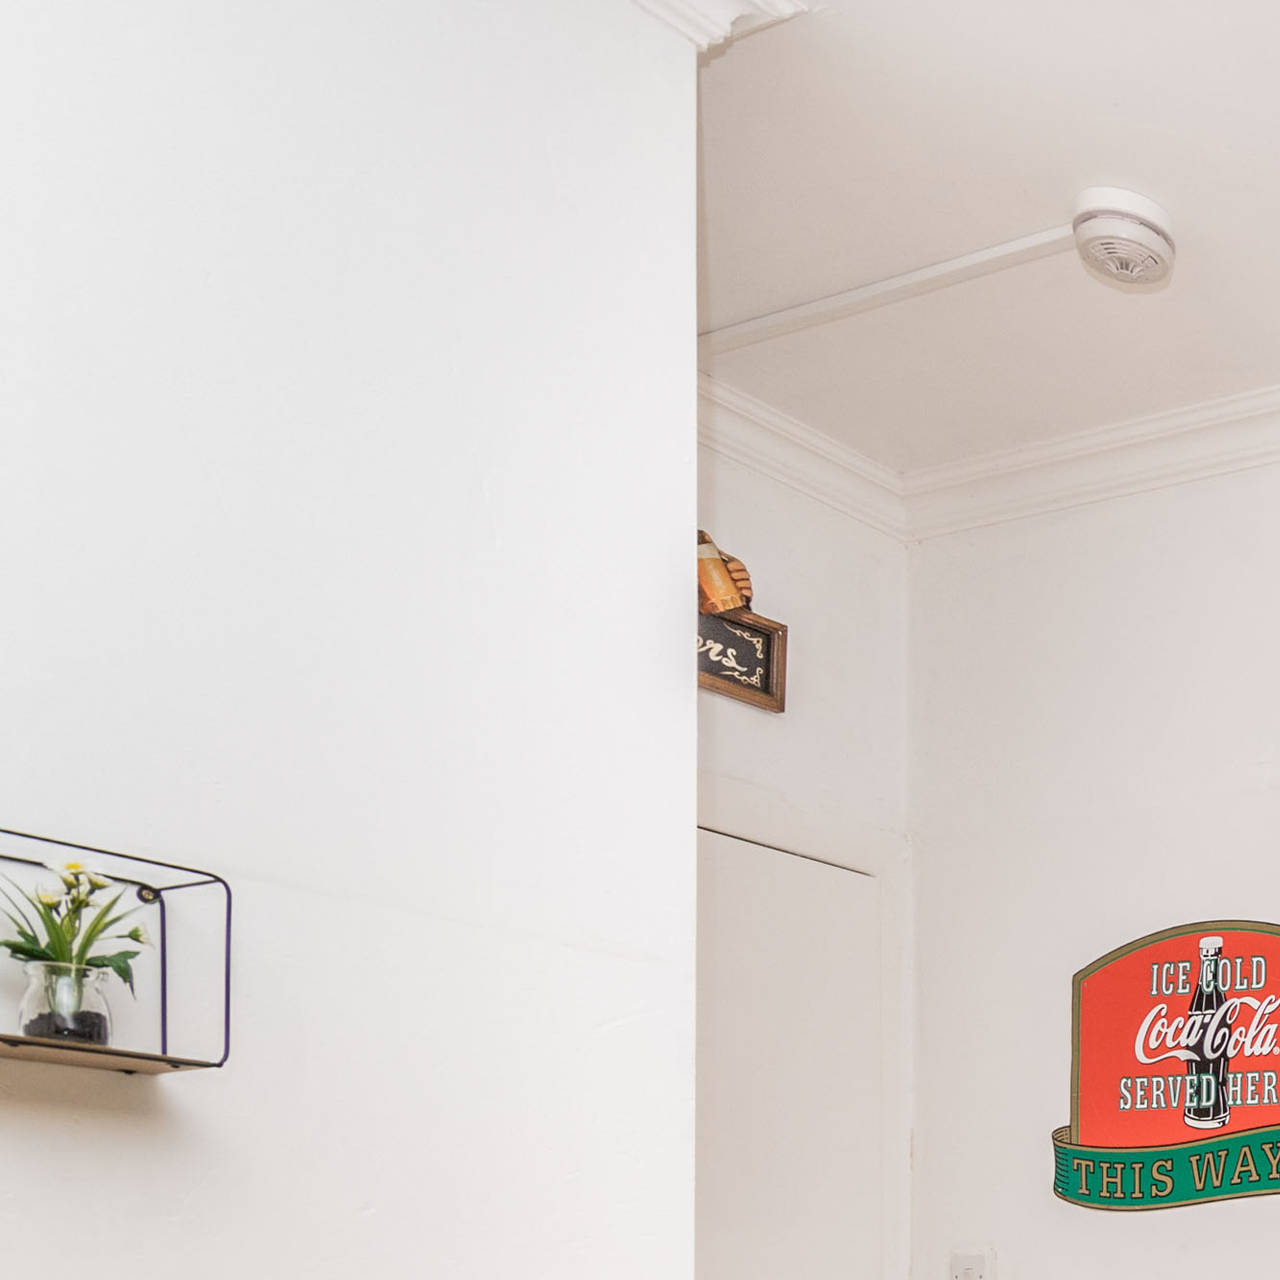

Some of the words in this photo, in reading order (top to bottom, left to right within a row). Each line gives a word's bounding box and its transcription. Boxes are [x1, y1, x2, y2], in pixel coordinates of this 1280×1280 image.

[1150, 961, 1191, 996] ICE
[1202, 955, 1267, 994] COLD
[1119, 1073, 1216, 1110] SERVED
[1072, 1157, 1174, 1199] THIS
